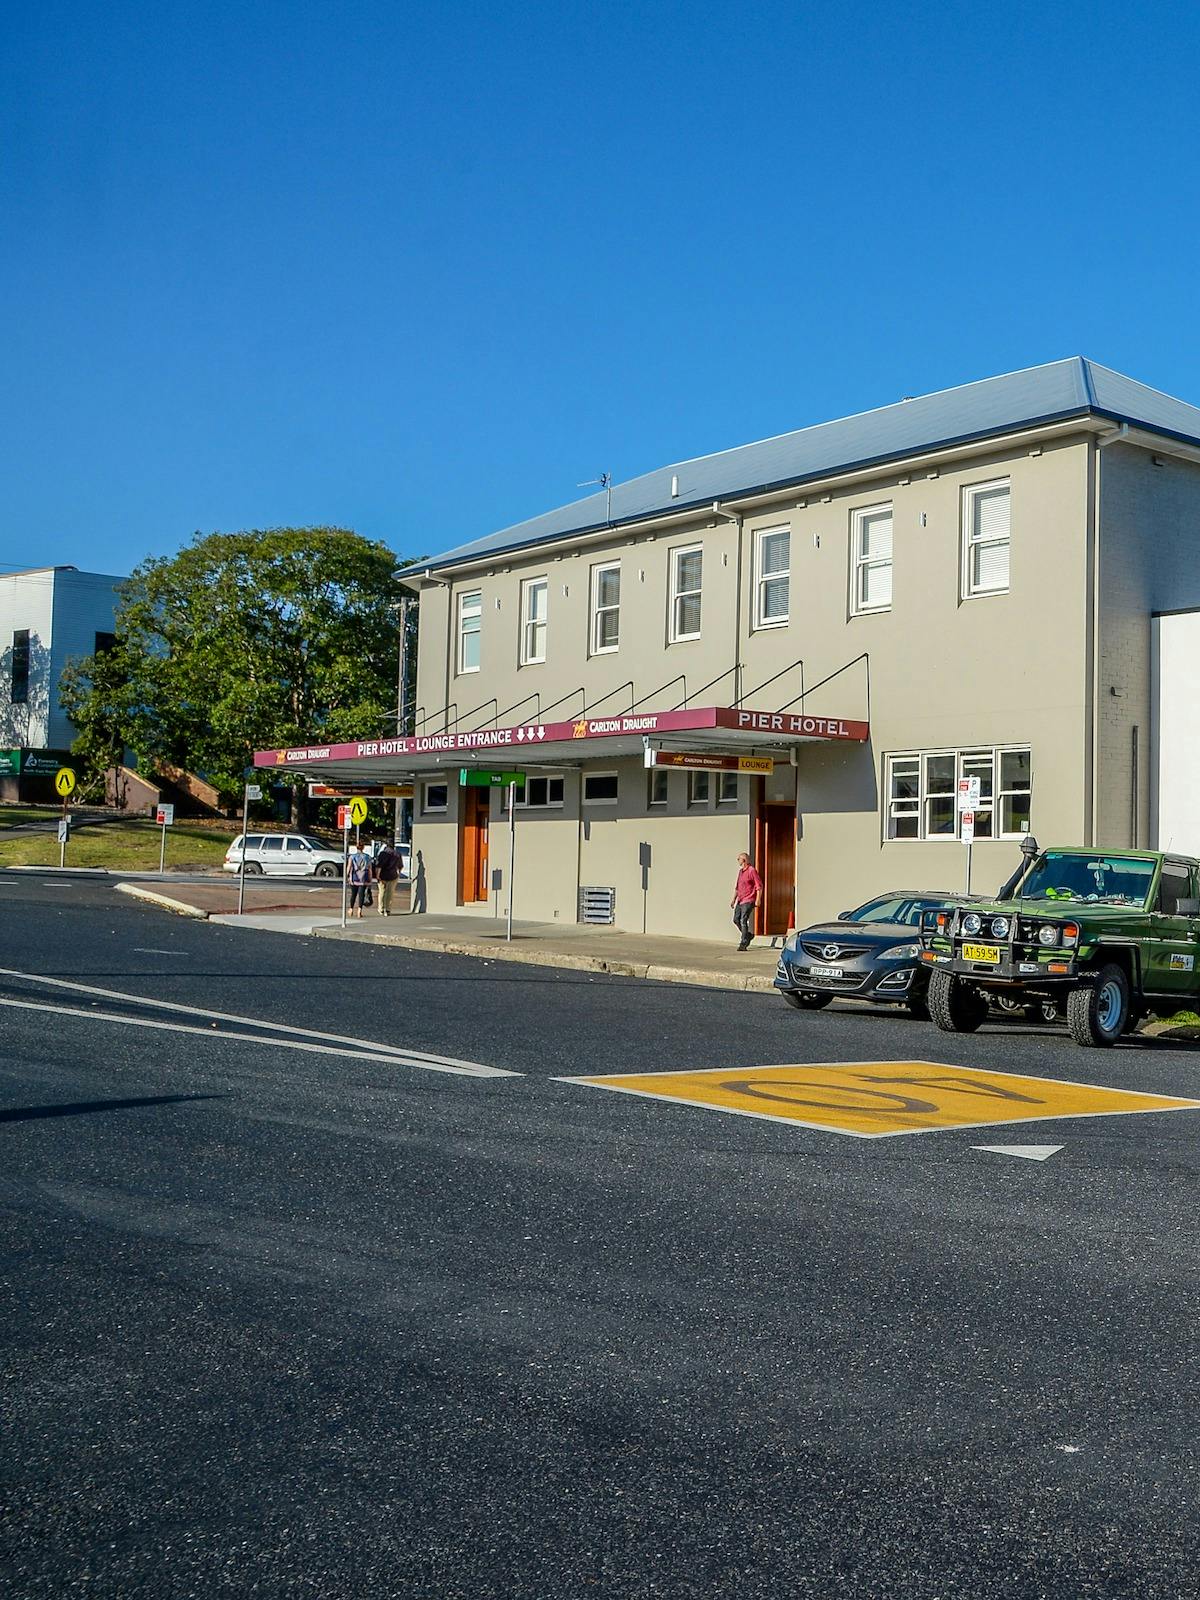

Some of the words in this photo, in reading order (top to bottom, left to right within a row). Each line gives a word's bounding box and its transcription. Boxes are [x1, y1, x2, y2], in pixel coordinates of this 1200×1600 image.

[589, 720, 620, 733] CARLTON
[623, 717, 658, 731] DRAUGHT
[738, 712, 783, 730] PIER
[790, 717, 849, 736] HOTEL
[357, 743, 378, 756] PIER
[380, 741, 409, 754] HOTEL
[416, 735, 455, 751] LOUNGE
[457, 730, 512, 747] ENTRANCE
[287, 750, 307, 760] CARLTON
[308, 748, 330, 758] DRAUGHT
[741, 760, 770, 770] LOUNGE
[964, 945, 974, 958] AT
[976, 947, 986, 959] 59
[987, 947, 998, 960] SM
